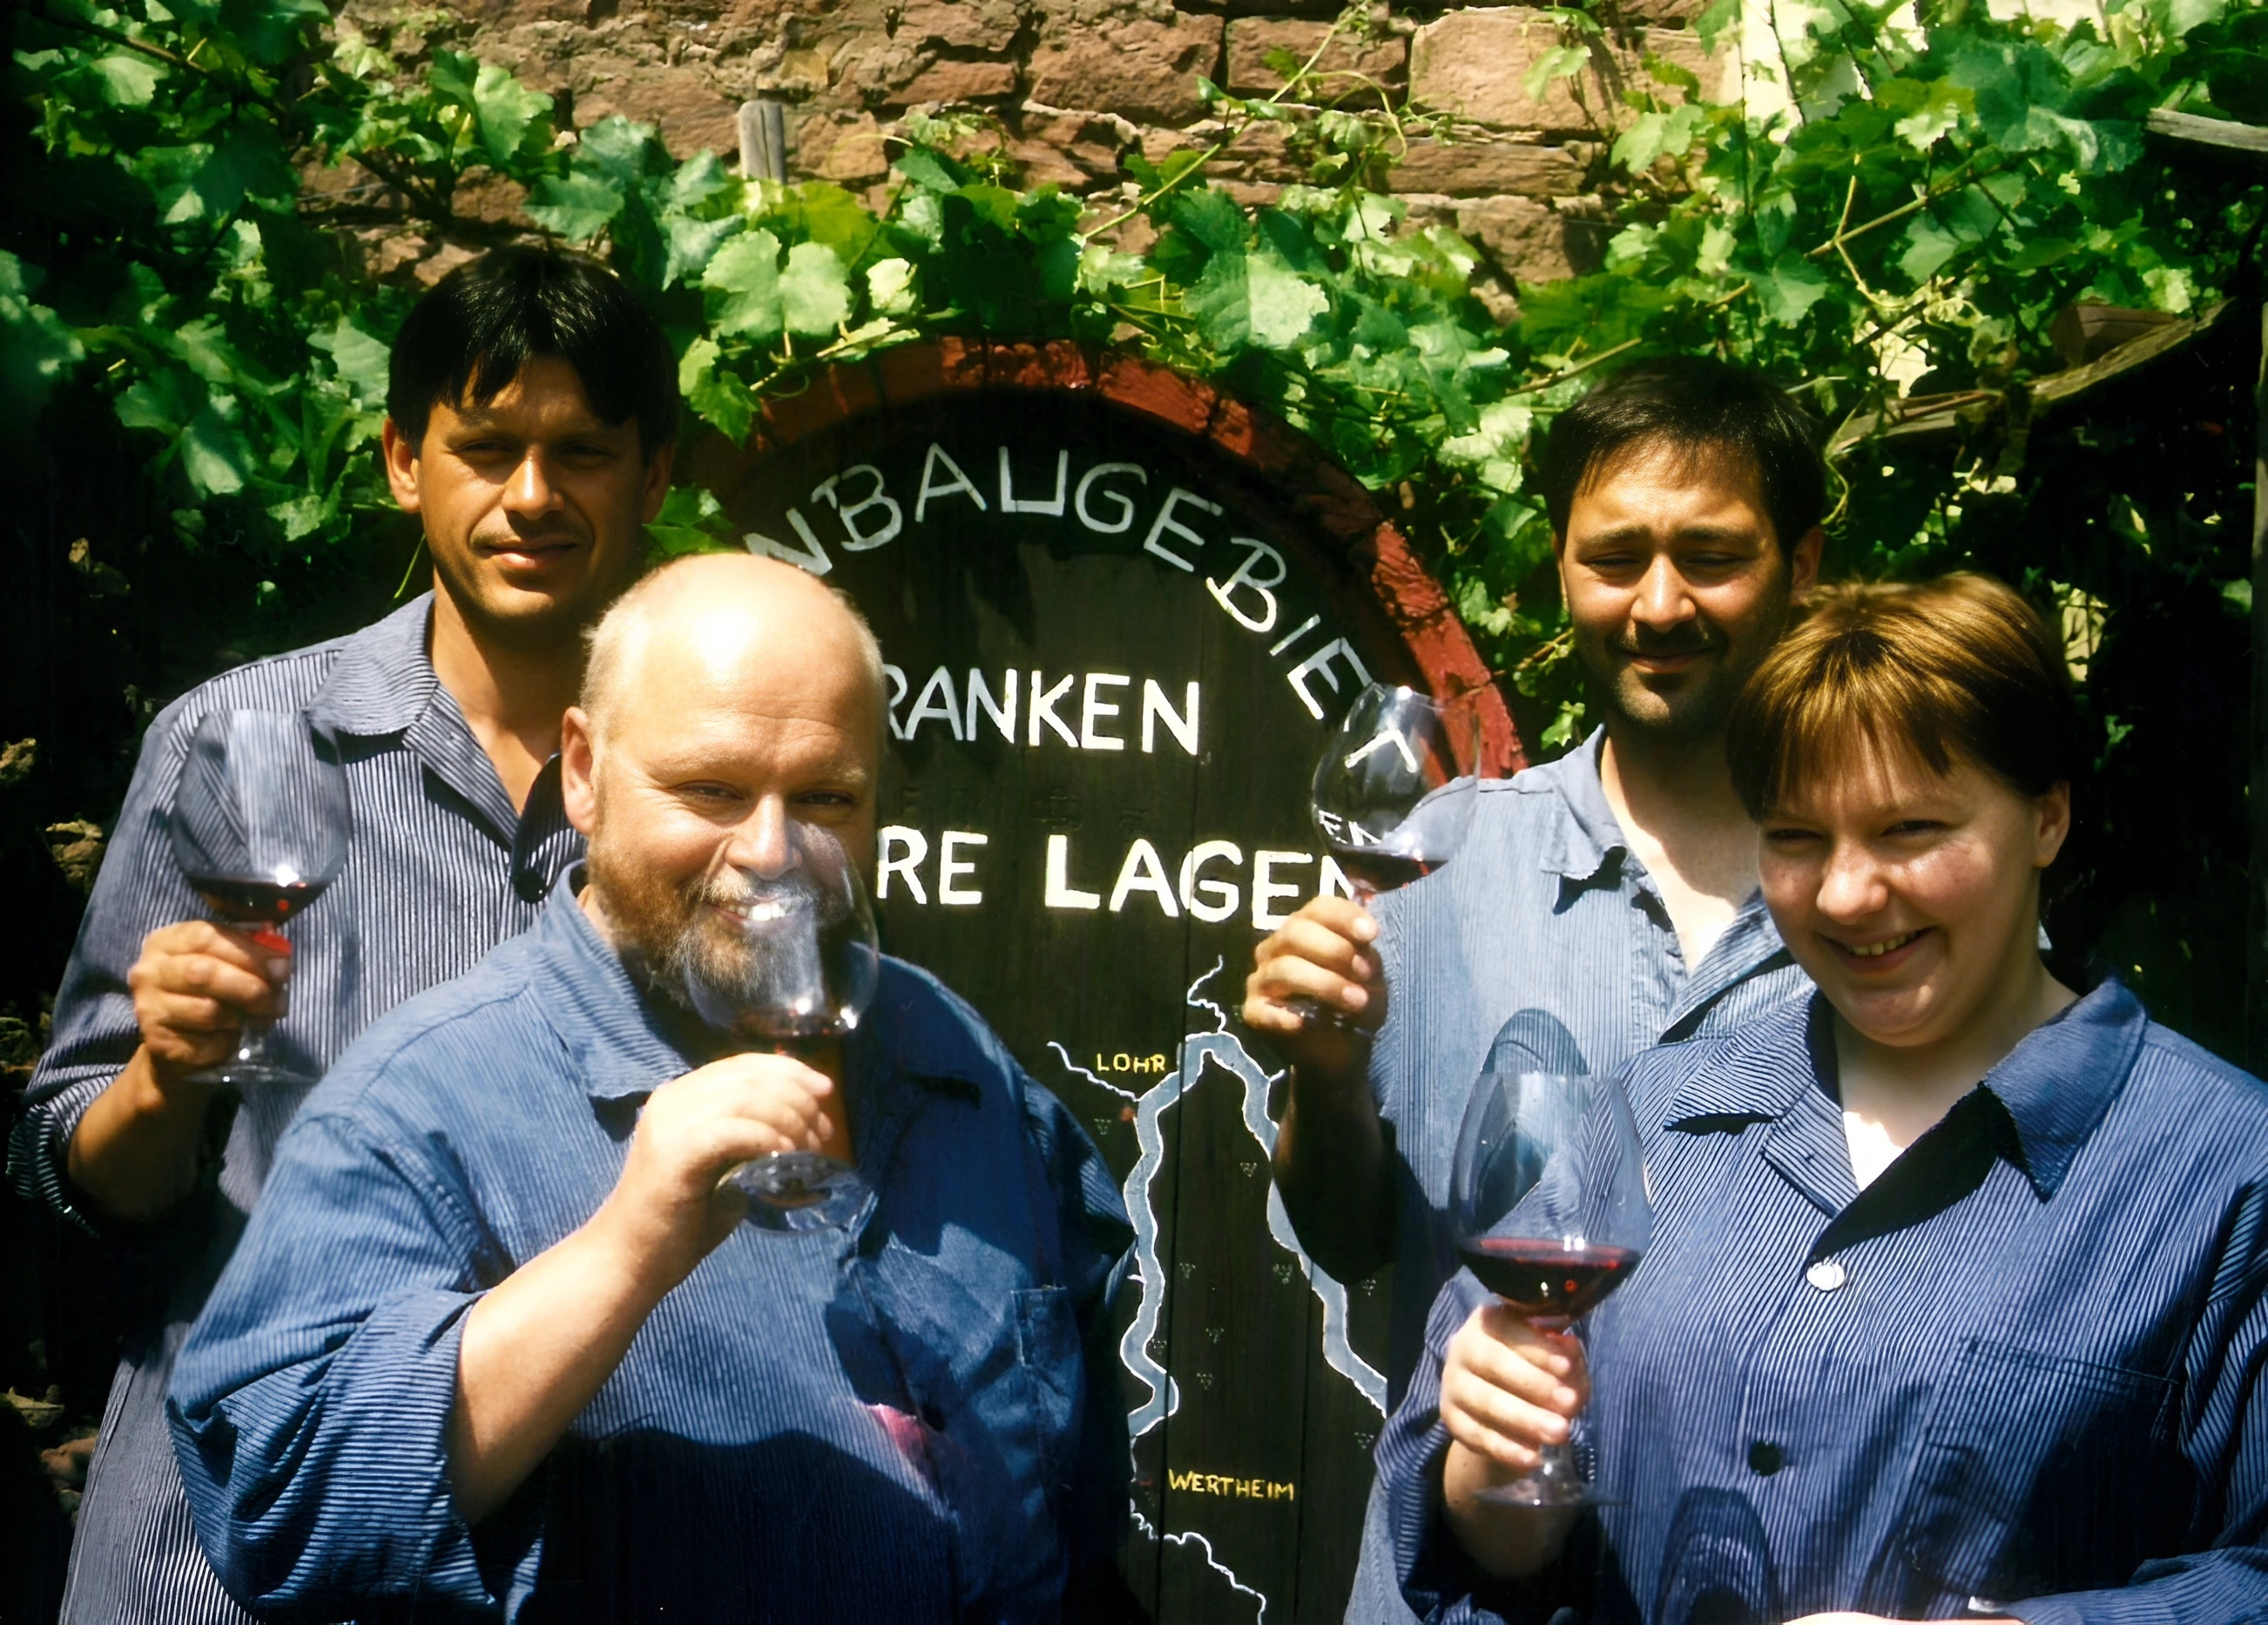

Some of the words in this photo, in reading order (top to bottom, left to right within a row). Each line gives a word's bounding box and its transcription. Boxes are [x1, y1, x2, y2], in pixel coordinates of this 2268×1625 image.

[743, 442, 1418, 772] NBAUGEBIET
[881, 664, 1200, 756] RANKEN
[877, 825, 989, 906] RE
[1096, 1053, 1166, 1074] LOHR
[1168, 1468, 1294, 1501] WERTHEIM
